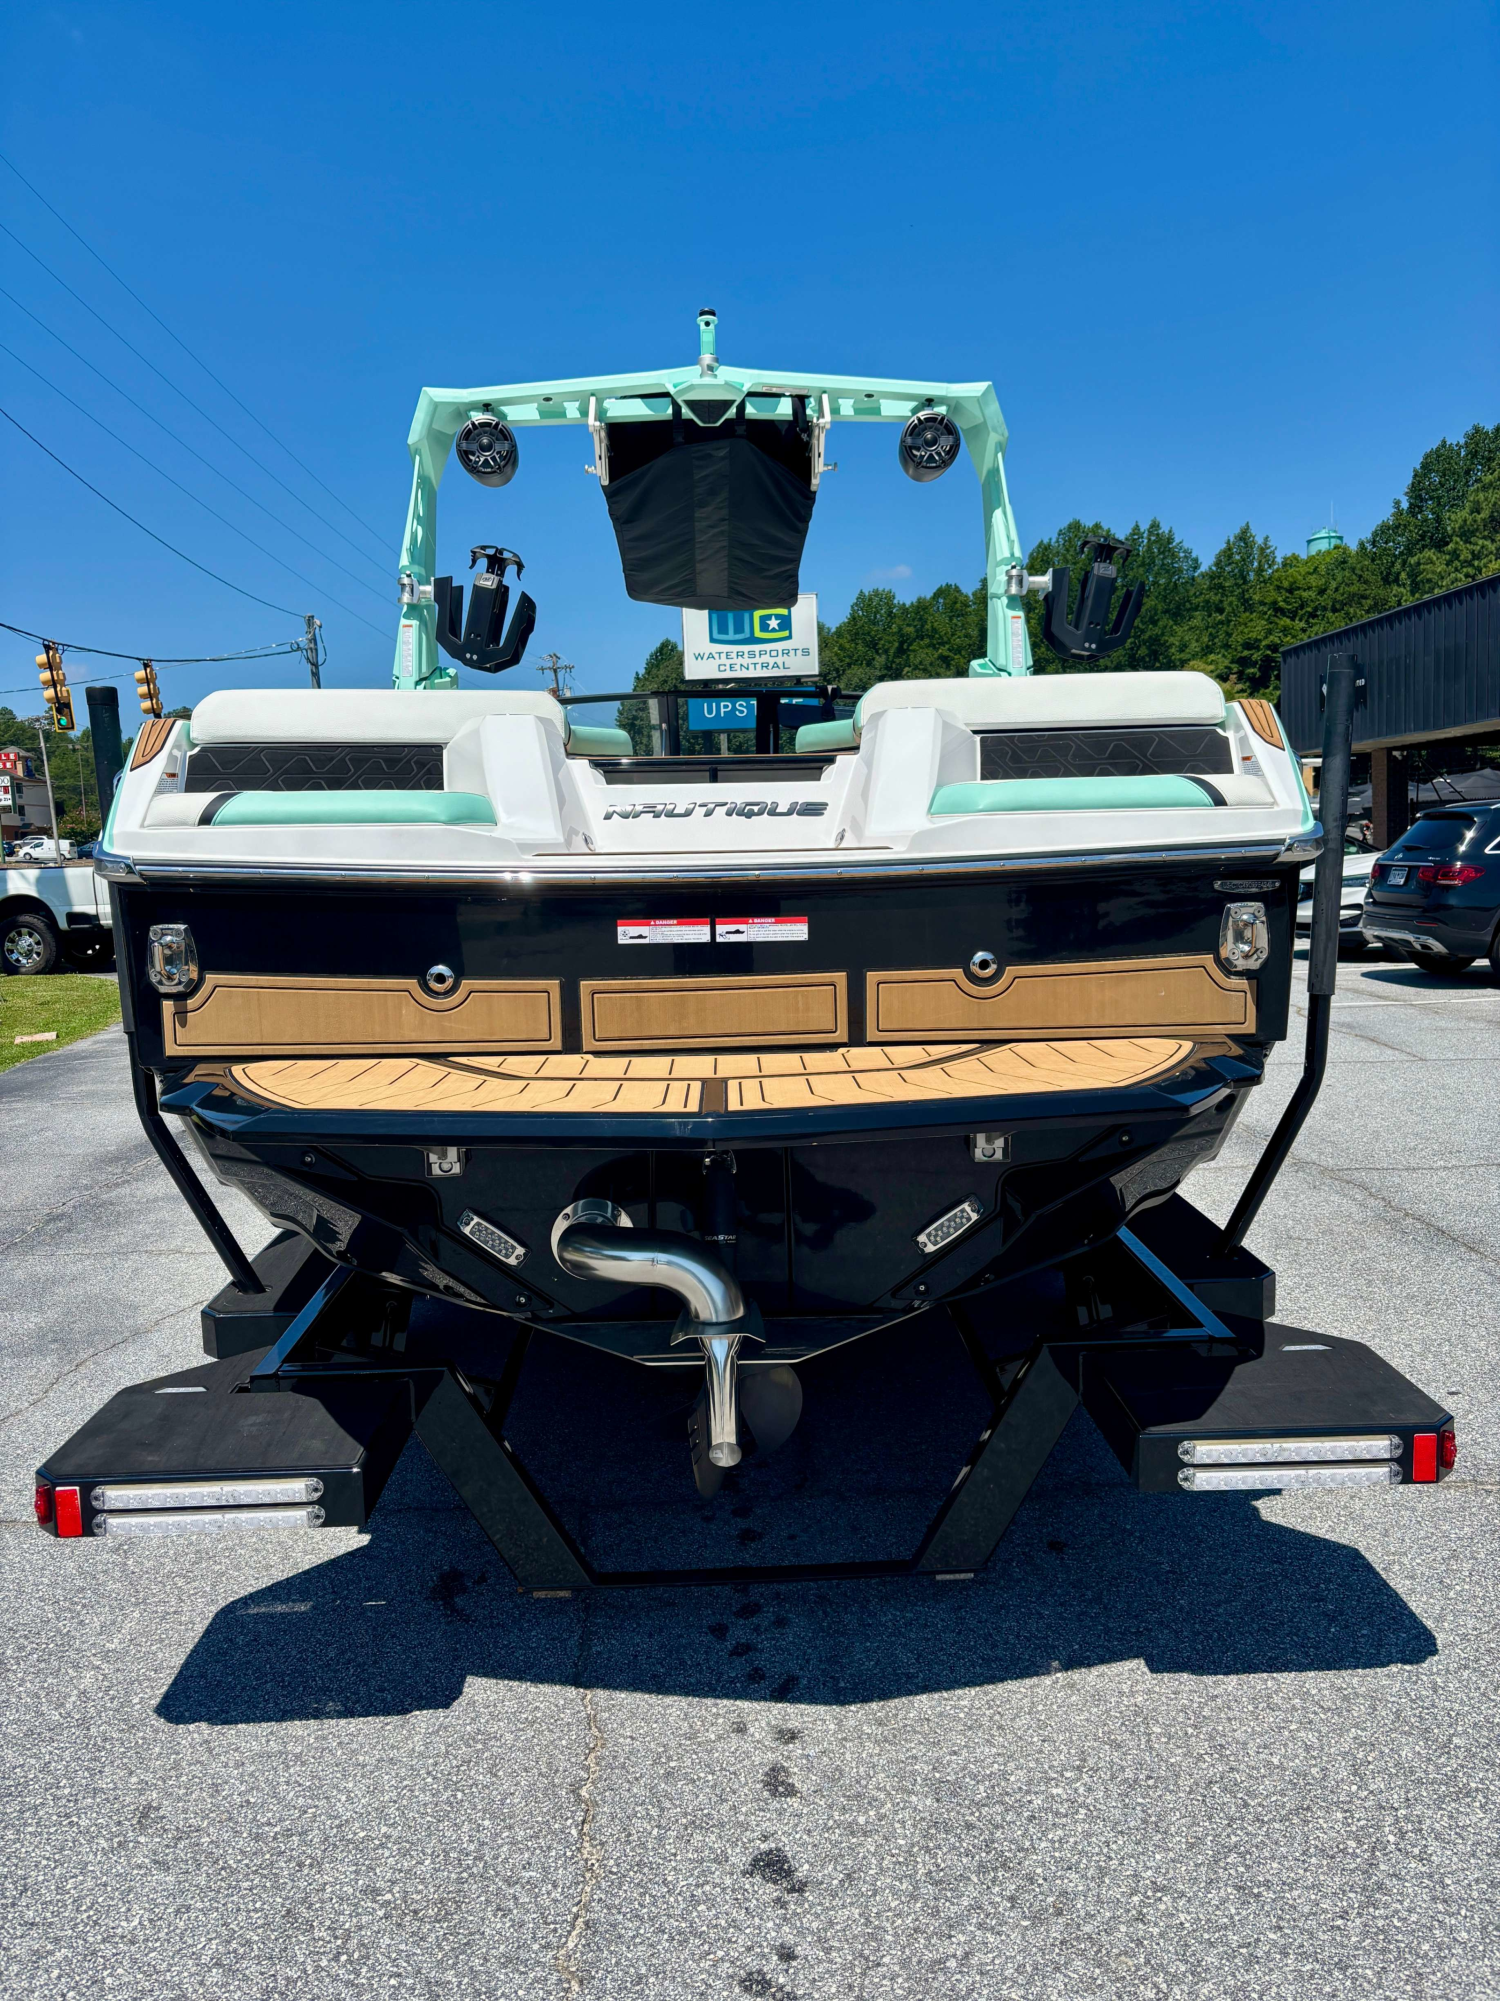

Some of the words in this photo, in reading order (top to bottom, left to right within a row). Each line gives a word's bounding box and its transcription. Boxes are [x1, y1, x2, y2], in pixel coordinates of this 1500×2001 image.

[693, 648, 811, 661] WATERSPORTS
[717, 661, 791, 673] CENTRAL
[603, 801, 829, 820] NAUTIQUE
